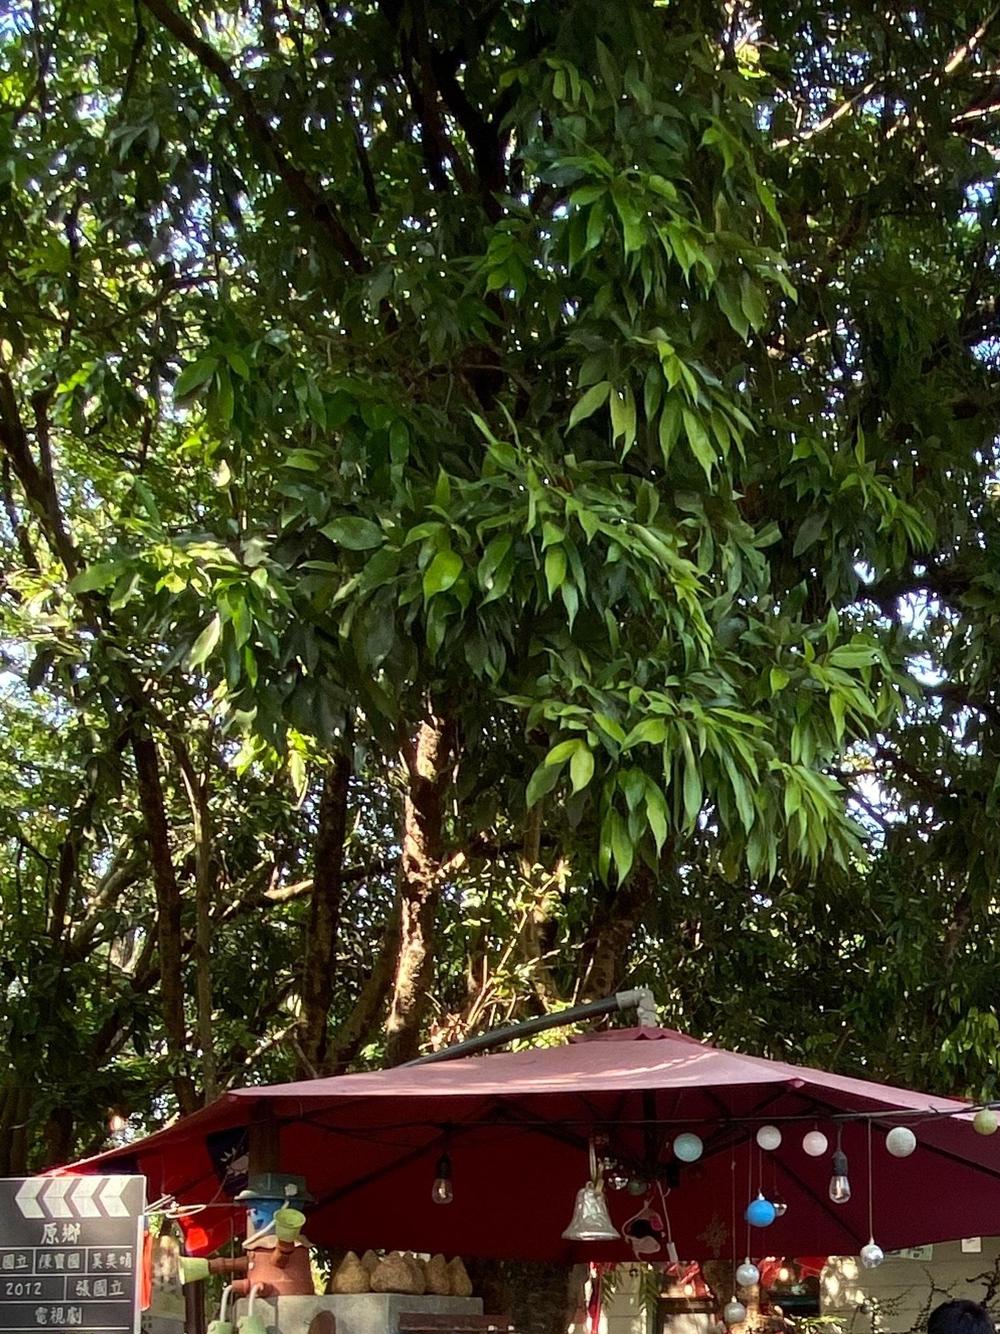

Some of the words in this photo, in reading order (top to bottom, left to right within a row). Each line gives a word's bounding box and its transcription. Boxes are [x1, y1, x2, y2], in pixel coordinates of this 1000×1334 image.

[40, 1222, 81, 1244] 原鄉
[0, 1254, 29, 1270] 國立
[5, 1282, 42, 1296] 2012
[75, 1278, 125, 1297] 張國立
[35, 1305, 82, 1325] 電視劇
